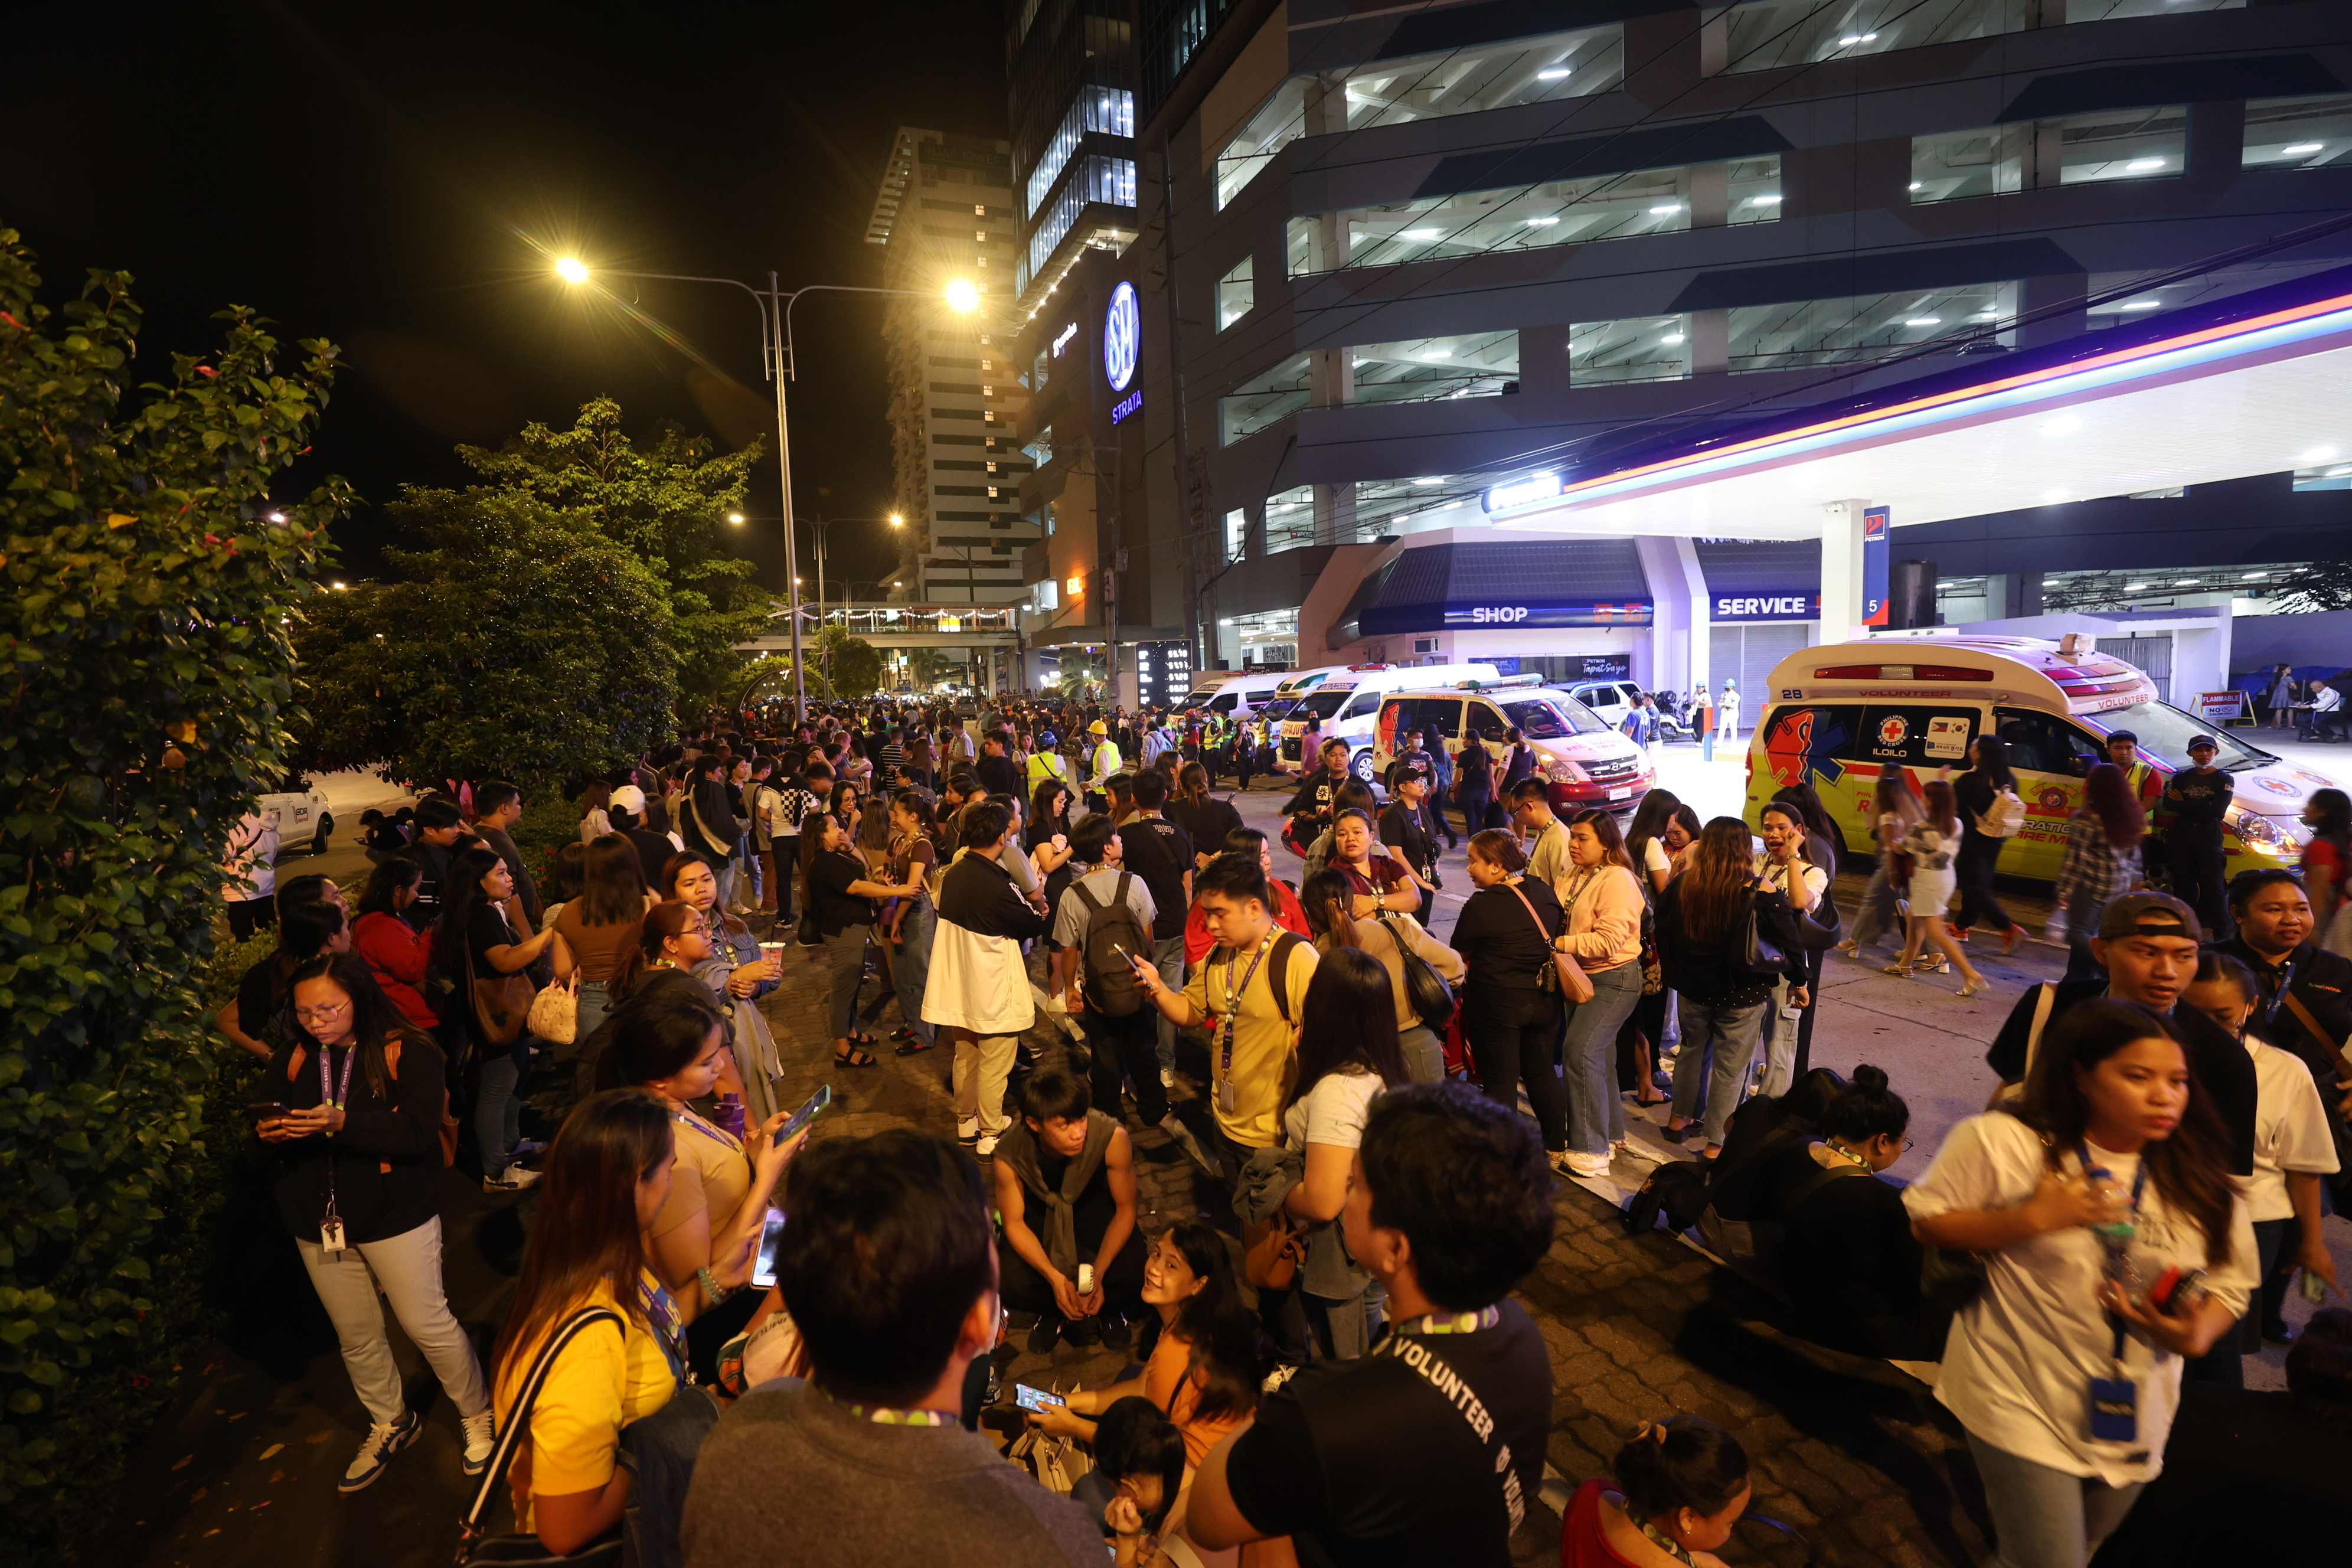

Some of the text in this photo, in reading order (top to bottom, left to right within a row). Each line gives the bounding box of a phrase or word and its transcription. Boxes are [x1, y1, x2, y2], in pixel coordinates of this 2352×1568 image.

[925, 146, 1000, 164] INJAP TOWER
[1112, 390, 1142, 424] STRATA
[1717, 597, 1805, 615] SERVICE
[1868, 600, 1877, 612] 5
[1472, 606, 1528, 623] SHOP
[1582, 662, 1627, 675] Tapat Sayo
[1782, 690, 1802, 699] 28
[2098, 693, 2149, 708] VOLUNTEER
[2203, 695, 2239, 703] FLAMMABLE
[1880, 715, 1909, 727] PHILIPPINE
[1877, 734, 1907, 747] RED CROSS
[1873, 748, 1907, 757] ILOILO
[1393, 1337, 1494, 1445] VOLUNTEER
